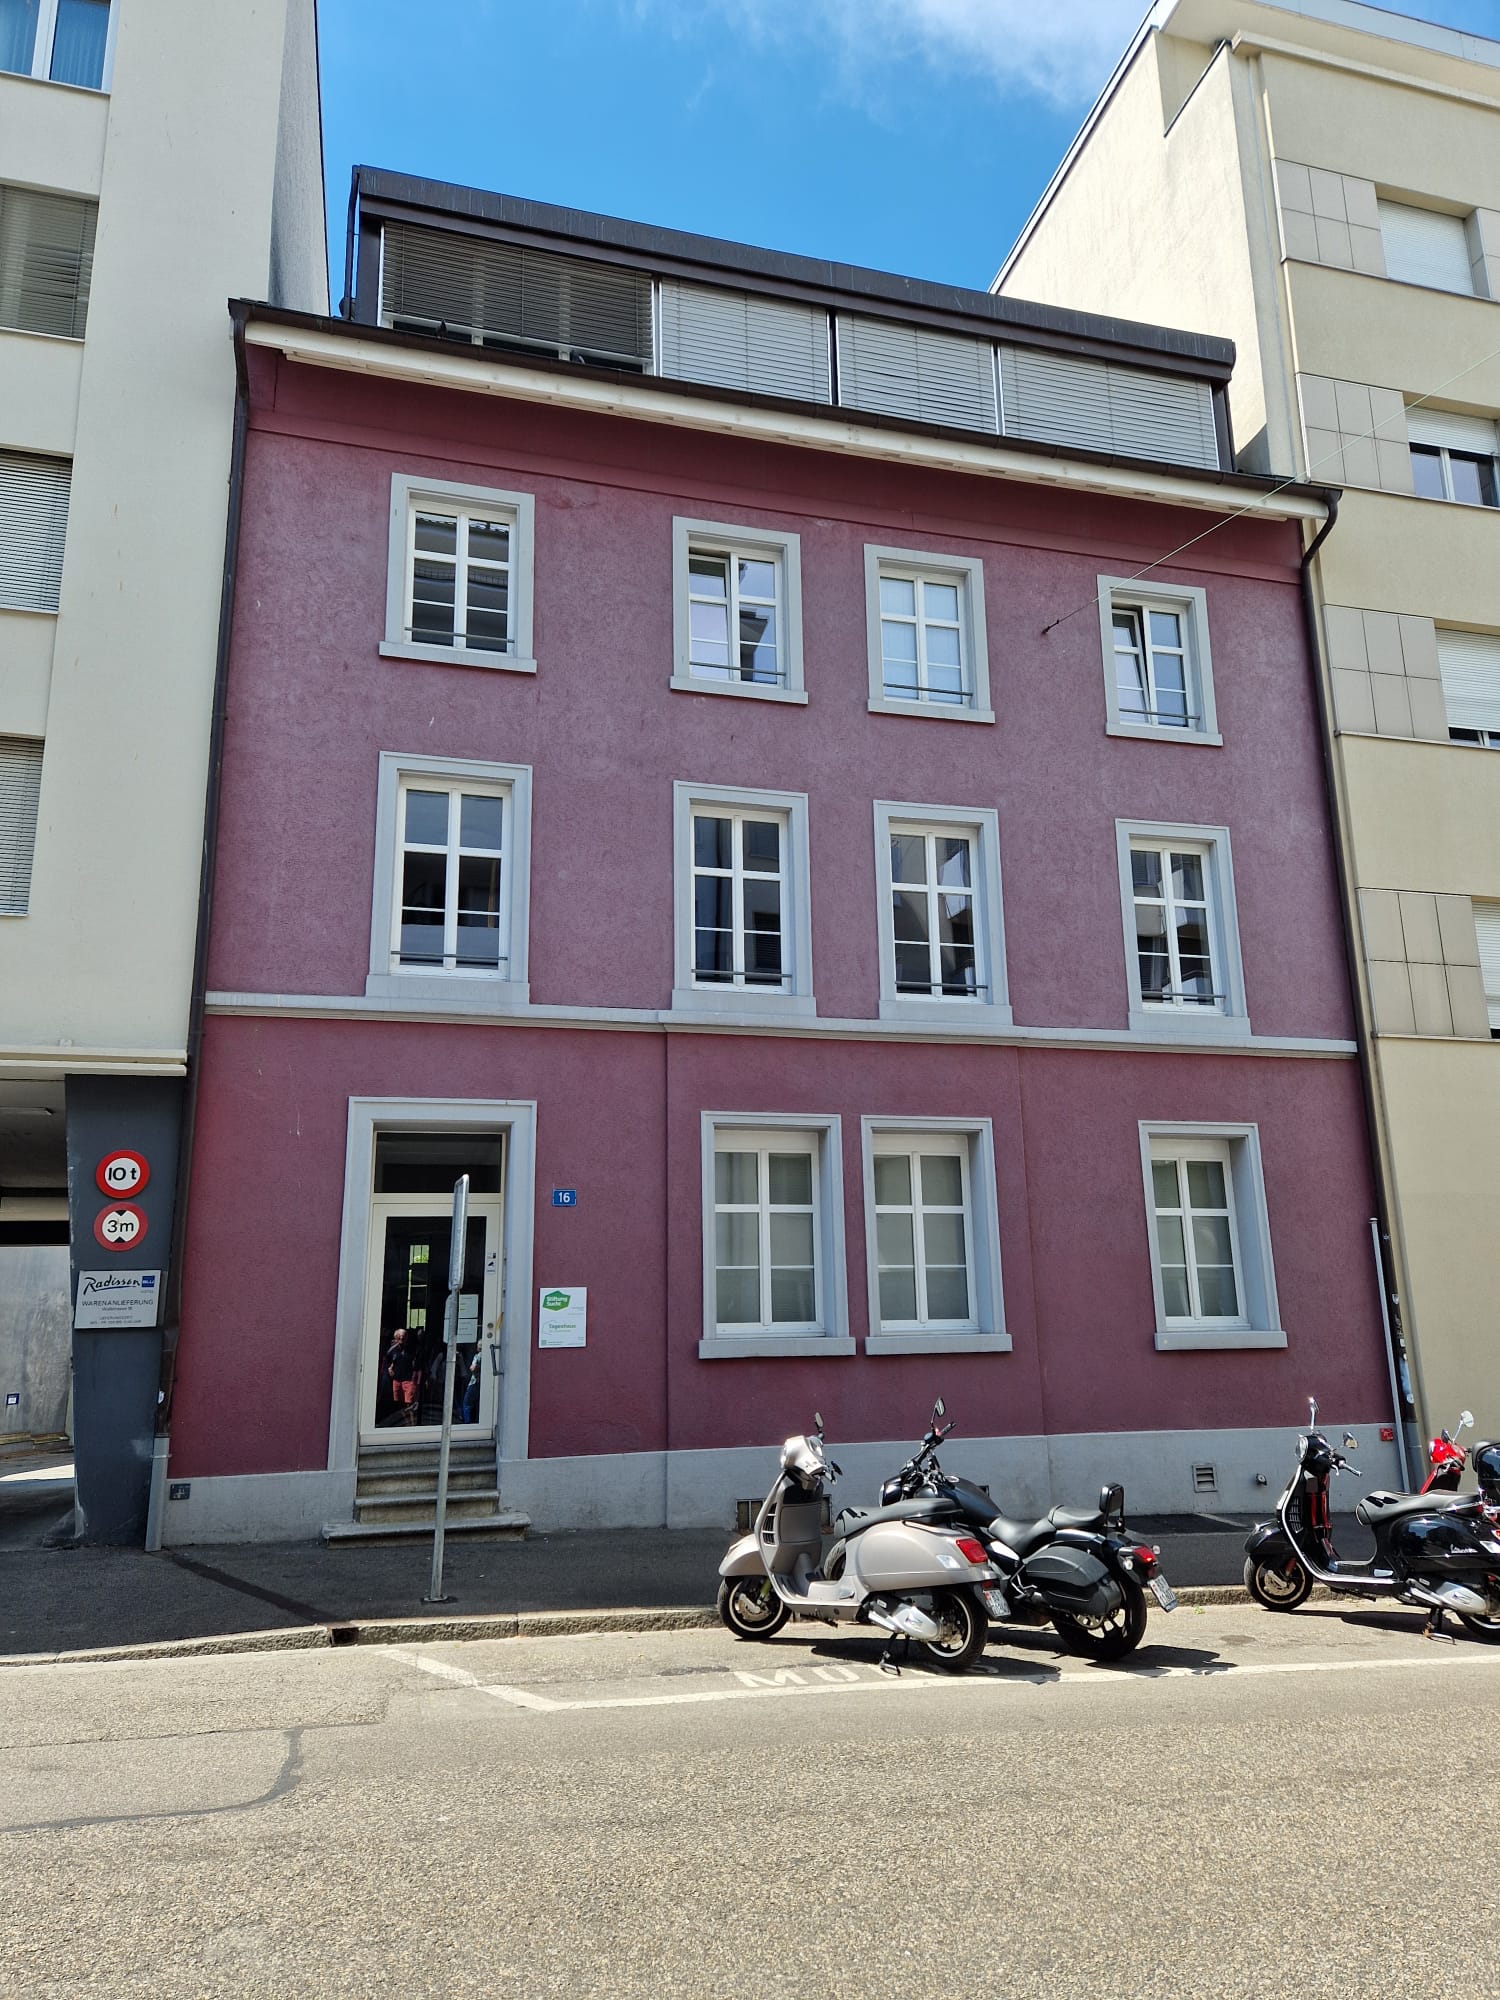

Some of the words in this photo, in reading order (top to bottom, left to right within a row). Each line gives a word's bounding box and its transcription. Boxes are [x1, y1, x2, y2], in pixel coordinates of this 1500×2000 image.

[108, 1167, 126, 1181] 10
[130, 1167, 137, 1180] t
[559, 1192, 570, 1203] 16
[83, 1274, 140, 1295] Radisson
